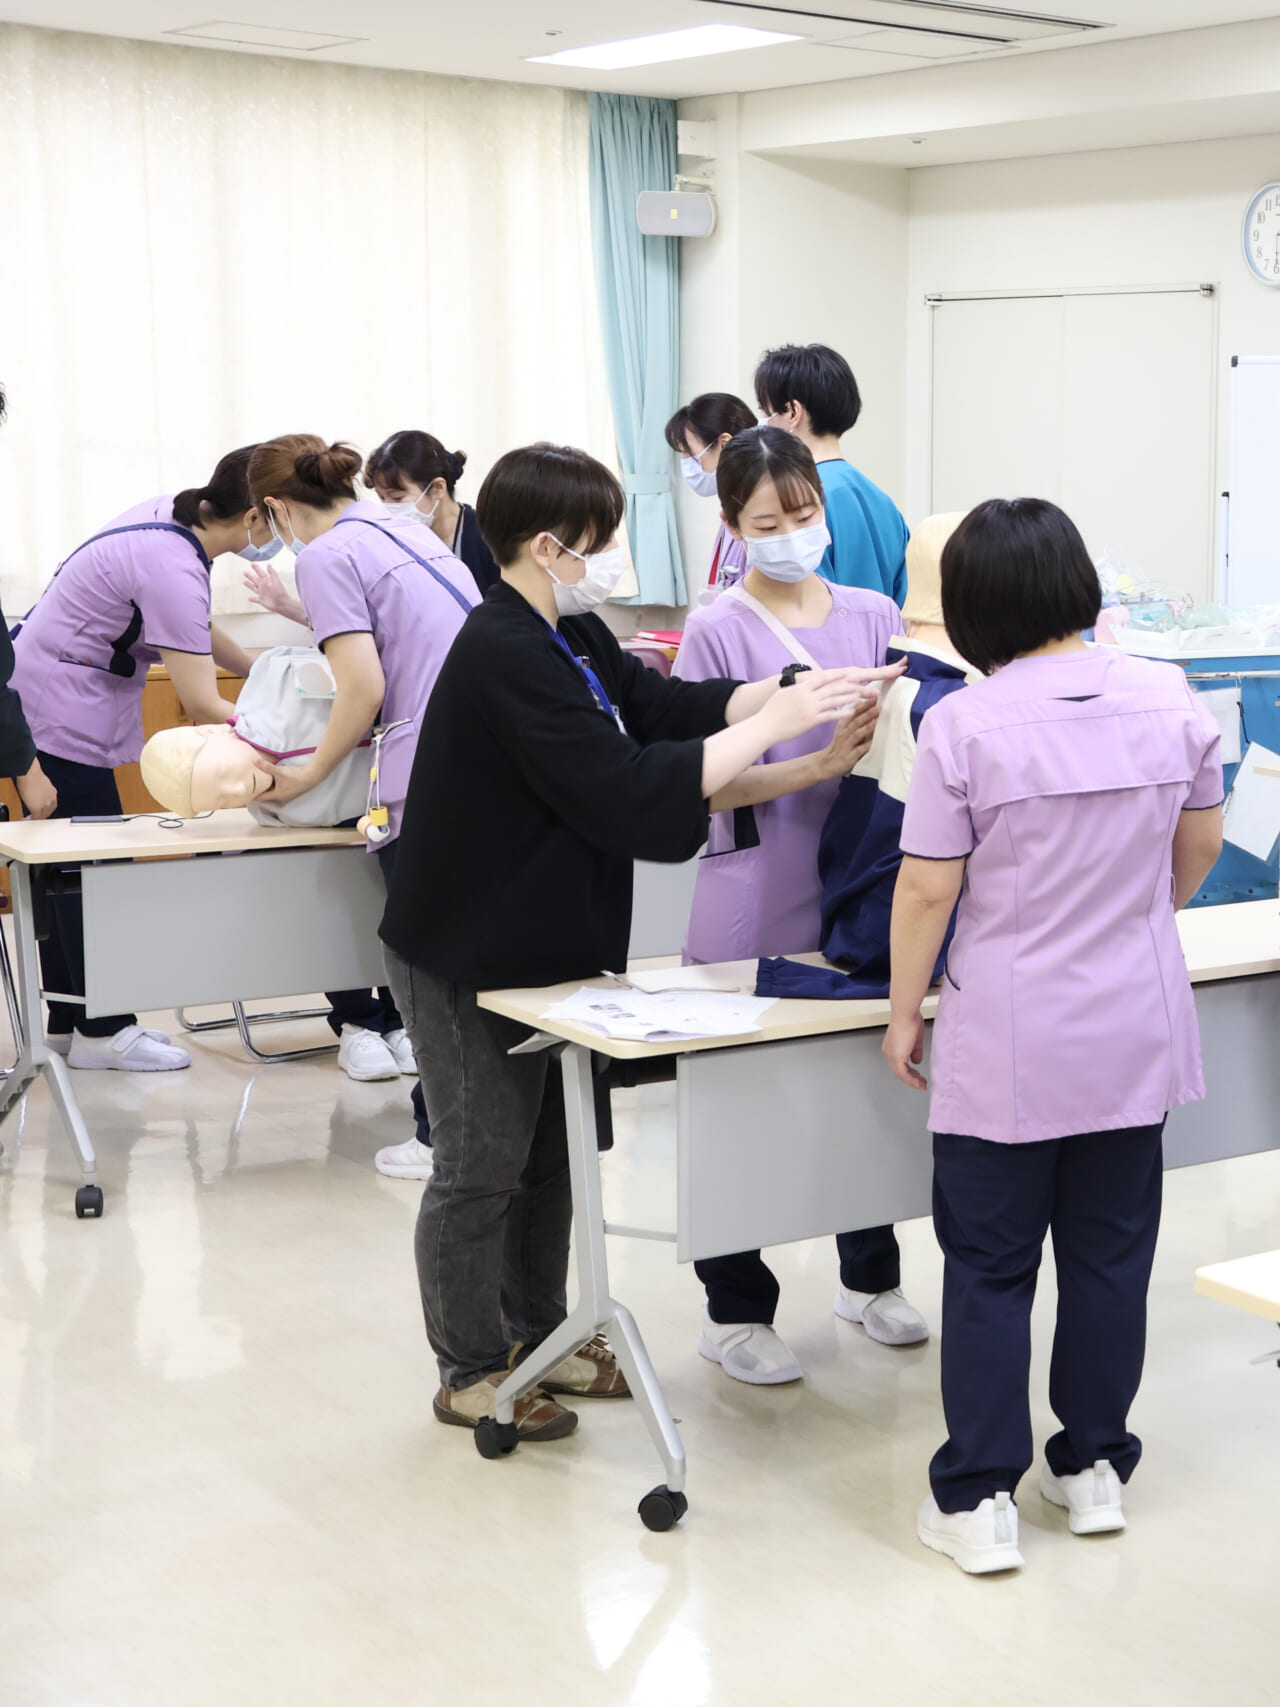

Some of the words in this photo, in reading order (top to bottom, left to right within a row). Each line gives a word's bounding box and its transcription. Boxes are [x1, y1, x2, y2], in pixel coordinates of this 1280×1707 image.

[1265, 198, 1272, 211] 11
[1257, 212, 1266, 224] 10
[1253, 229, 1260, 242] 9
[1256, 246, 1263, 258] 8
[1264, 258, 1270, 271] 7
[1274, 262, 1280, 274] 6
